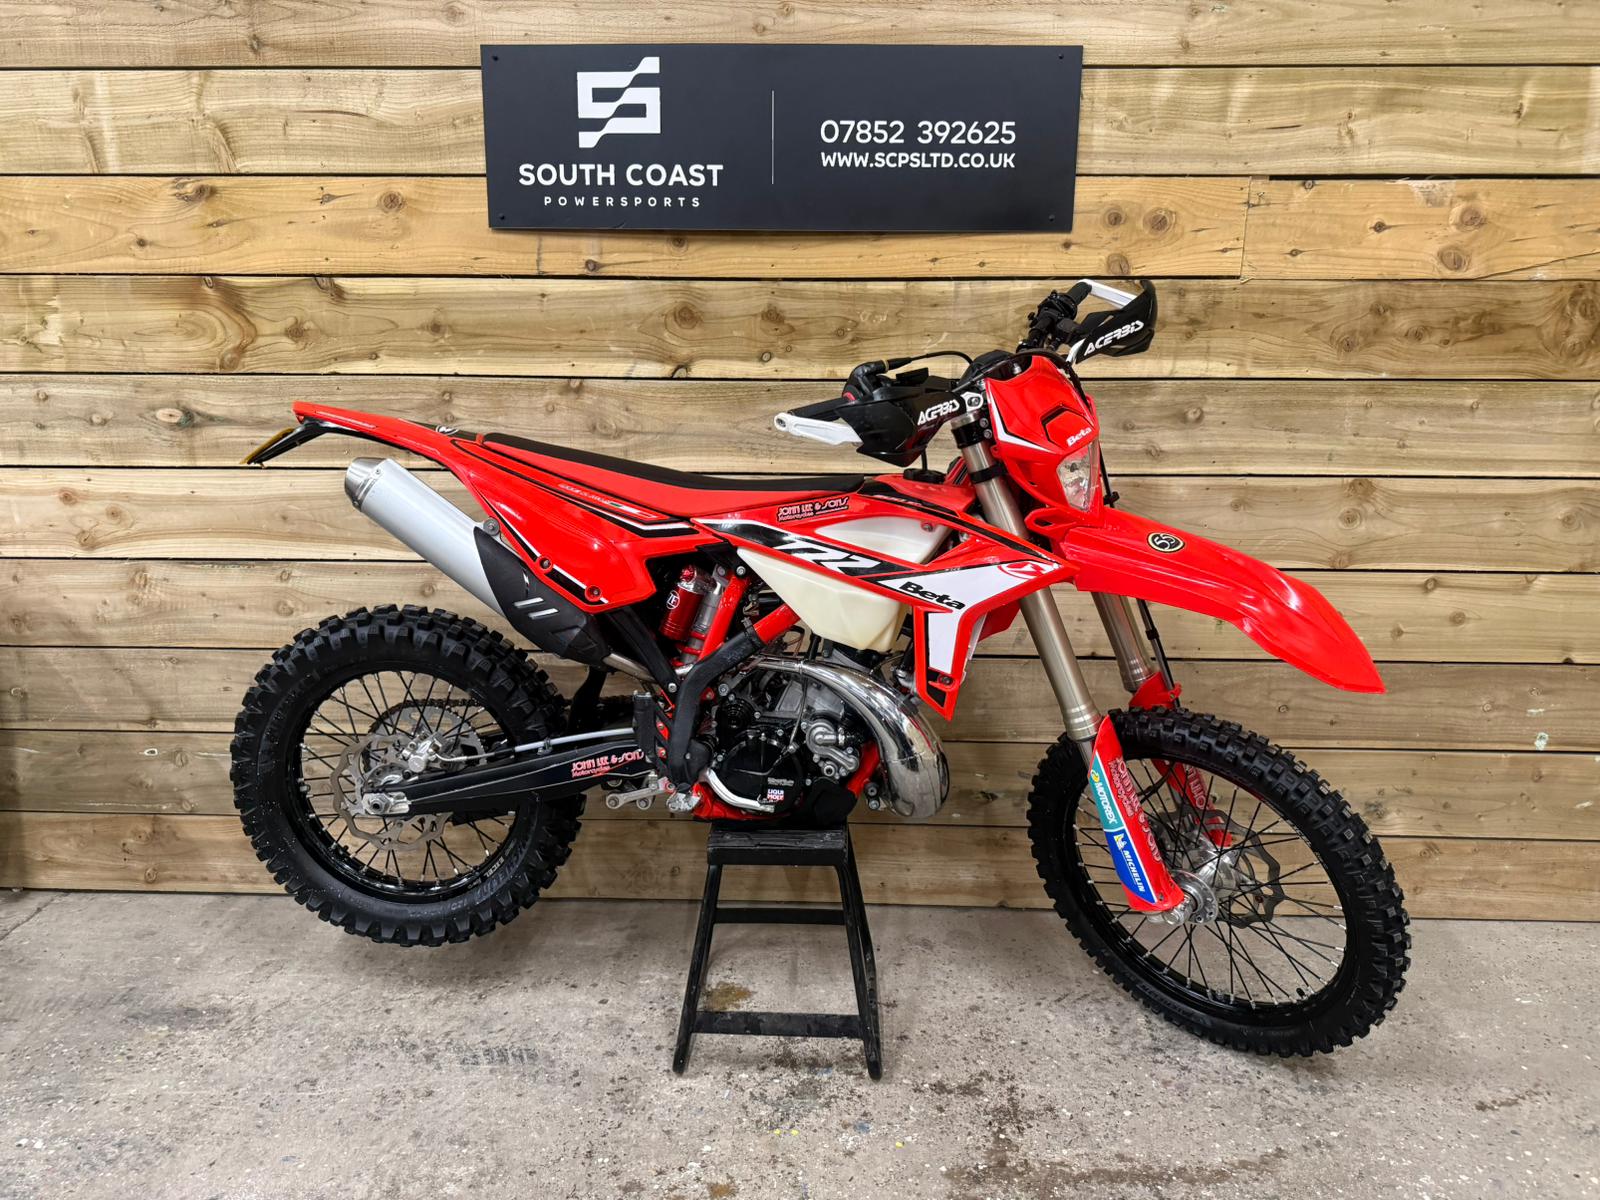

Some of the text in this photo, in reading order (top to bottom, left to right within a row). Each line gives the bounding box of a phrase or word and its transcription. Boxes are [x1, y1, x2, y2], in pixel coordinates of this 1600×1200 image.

[820, 119, 1016, 145] 07852 392625
[820, 151, 1016, 169] WWW.SCPSLTD.CO.UK
[518, 163, 724, 187] SOUTH COAST
[543, 195, 700, 208] POWERSPORTS
[1083, 319, 1144, 356] ACERBIS
[916, 398, 960, 426] ACERBIS
[1066, 426, 1092, 447] Beta
[899, 581, 966, 610] Beta
[1094, 782, 1118, 824] MOTOREX
[1122, 849, 1146, 893] MICHELIN
